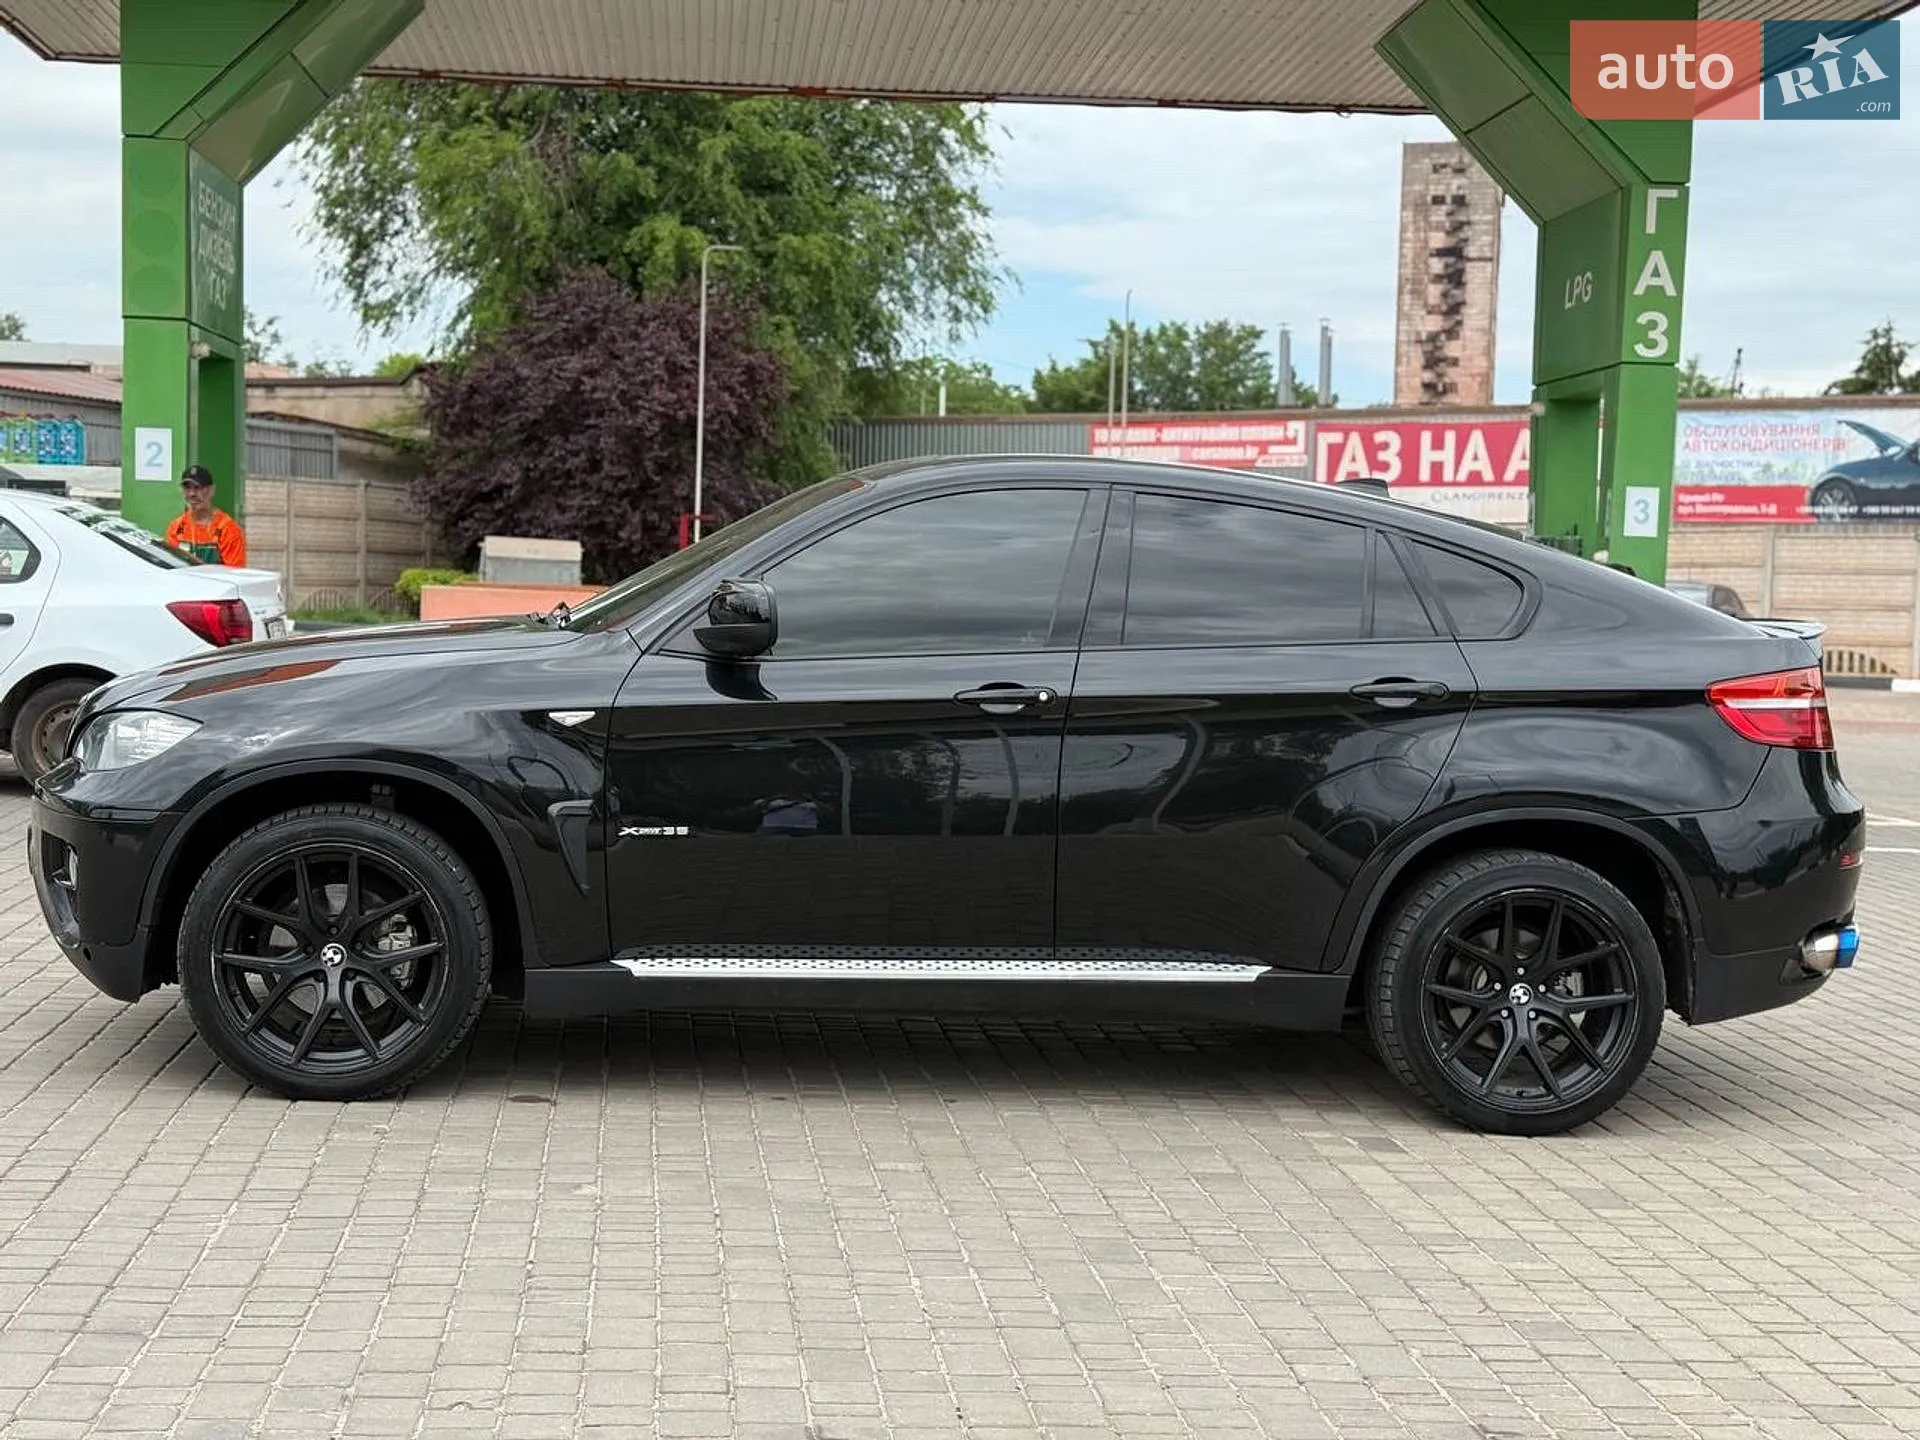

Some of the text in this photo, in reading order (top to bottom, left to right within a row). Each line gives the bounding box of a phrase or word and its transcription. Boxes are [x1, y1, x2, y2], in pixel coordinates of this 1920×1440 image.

[1564, 271, 1594, 311] LPG
[144, 441, 165, 468] 2
[1316, 430, 1402, 483] ГАЗ
[1418, 429, 1496, 483] НА
[1633, 498, 1651, 525] 3
